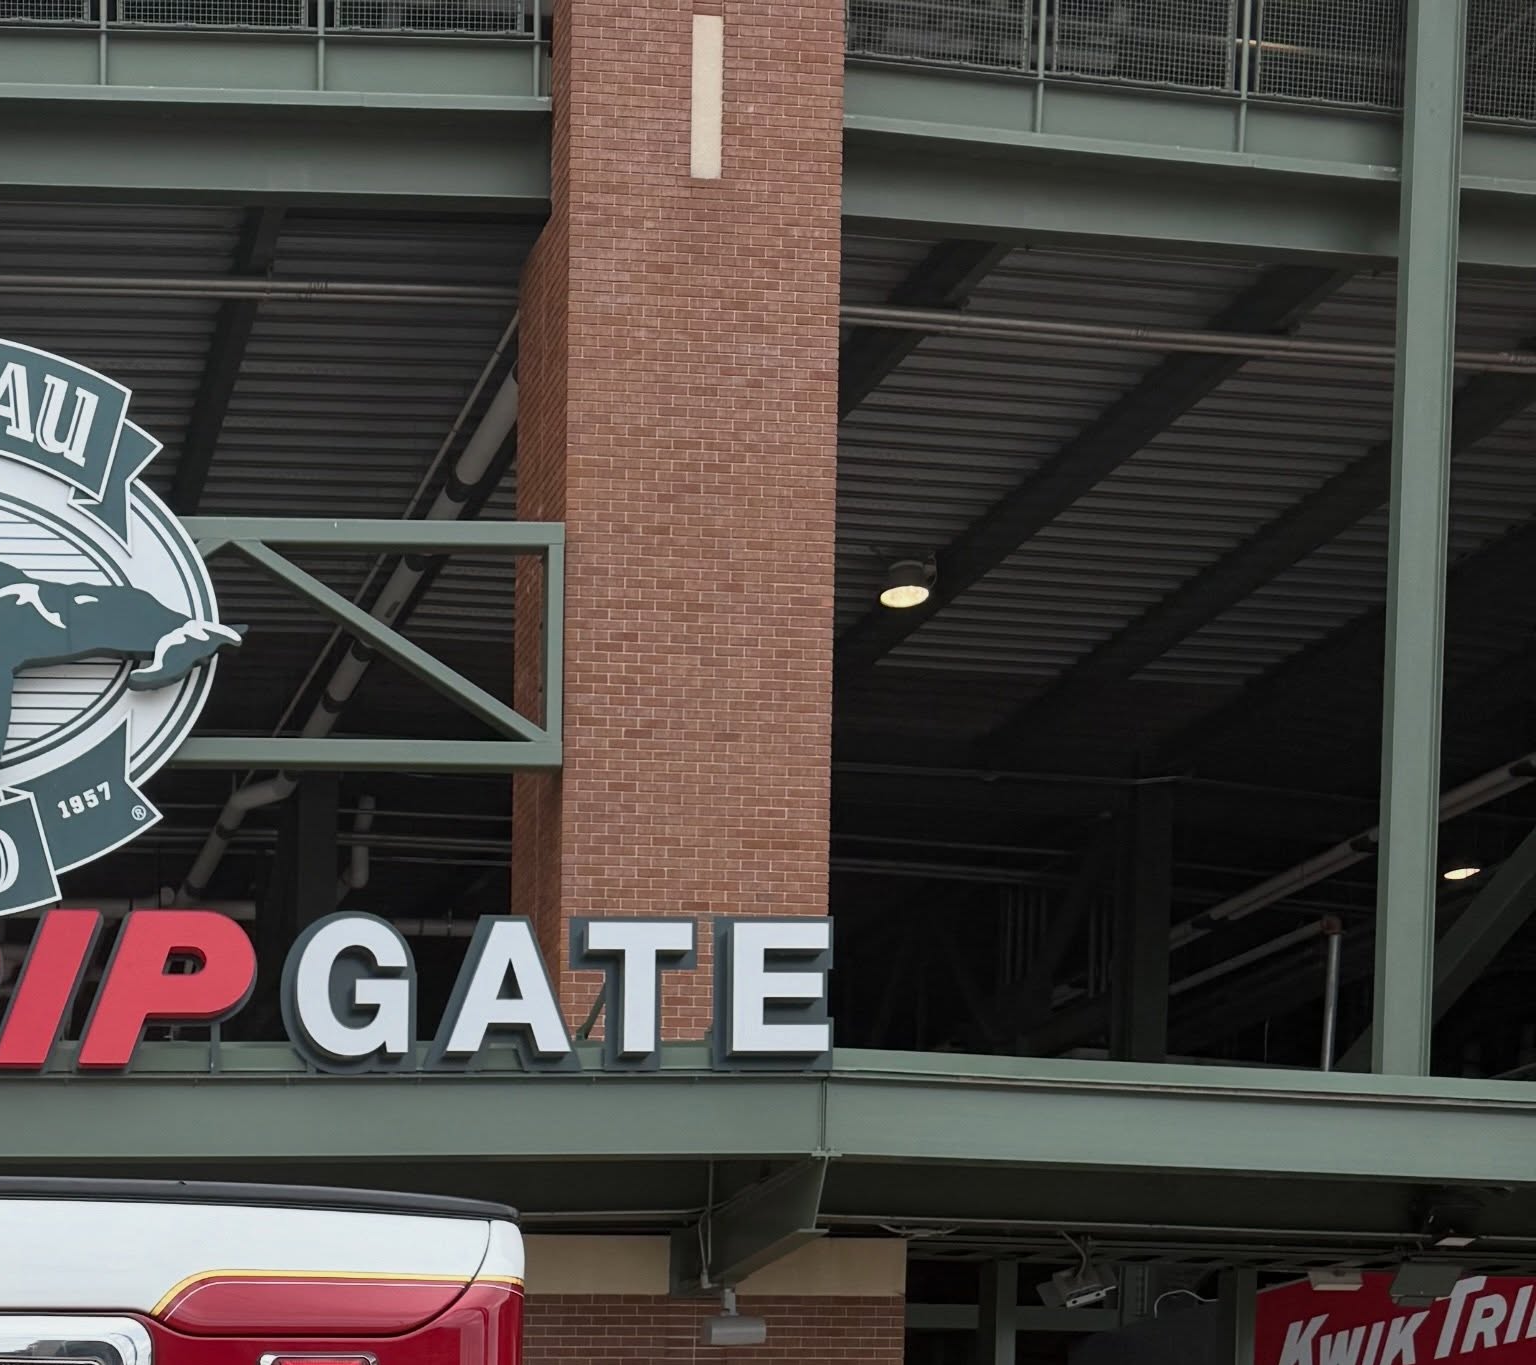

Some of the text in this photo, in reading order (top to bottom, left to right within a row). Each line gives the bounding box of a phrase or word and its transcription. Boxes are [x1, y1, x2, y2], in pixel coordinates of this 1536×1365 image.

[56, 781, 113, 819] 1957
[290, 914, 833, 1064] GATE
[1434, 1275, 1536, 1360] TRI
